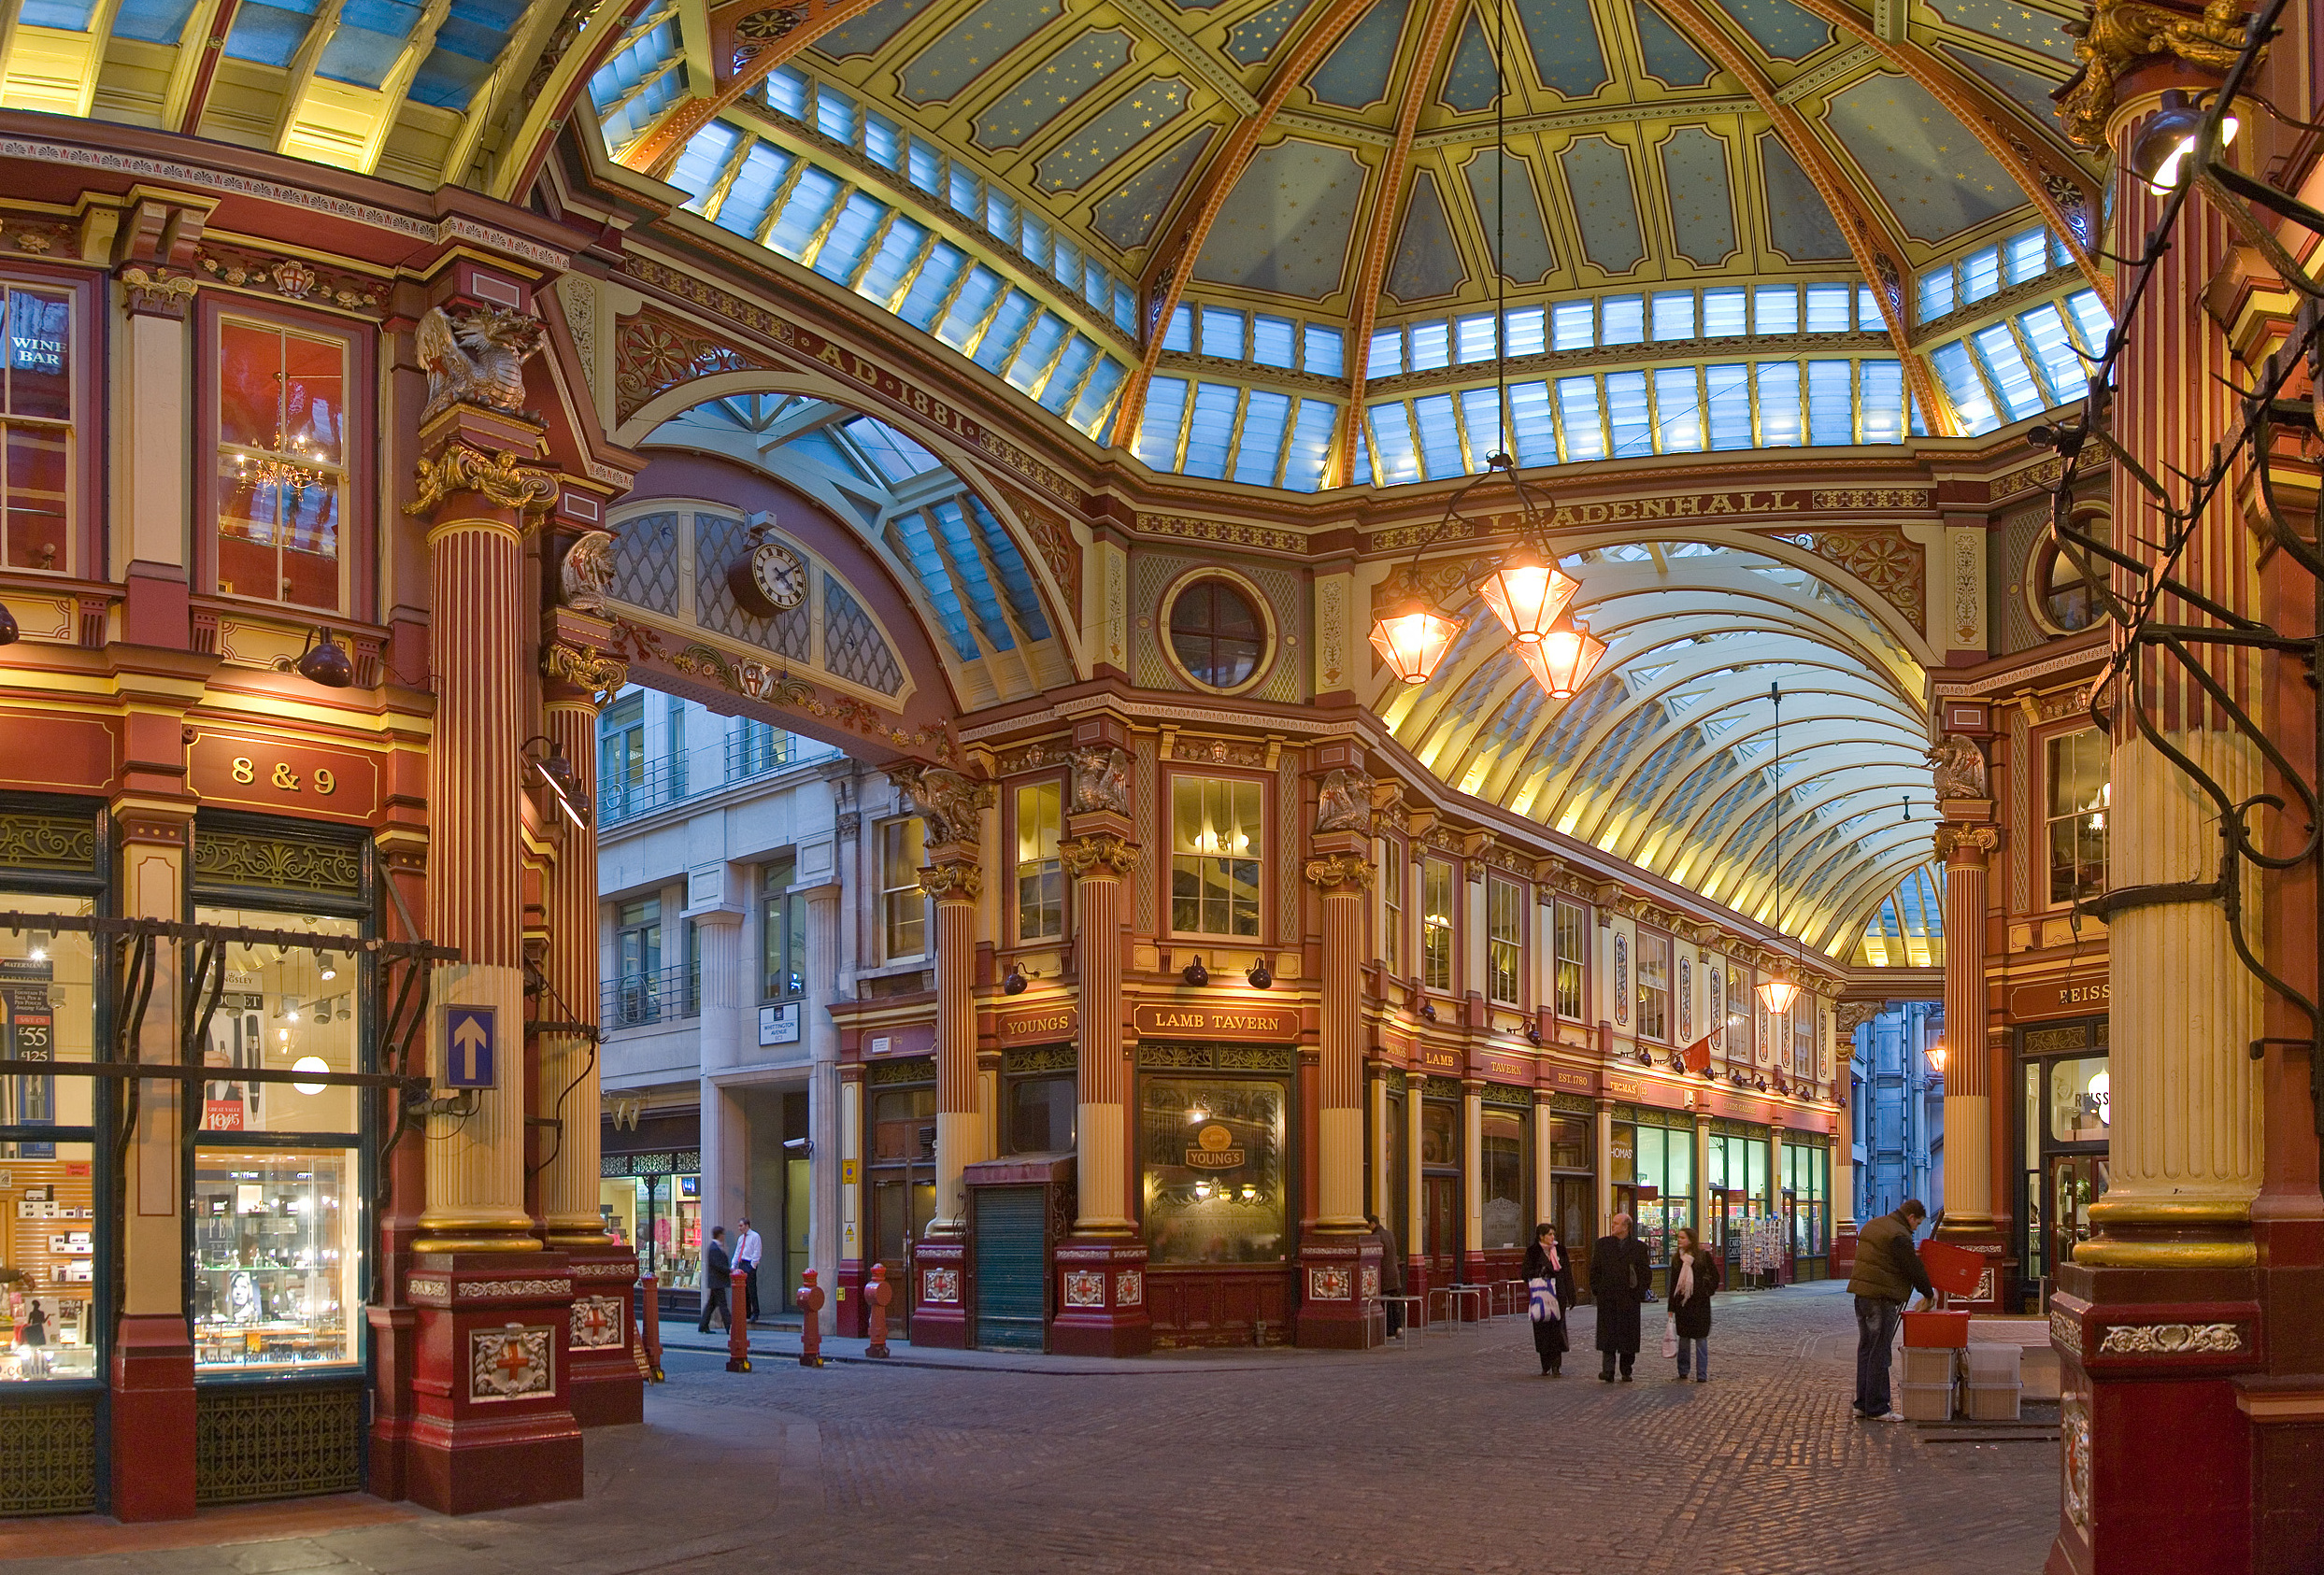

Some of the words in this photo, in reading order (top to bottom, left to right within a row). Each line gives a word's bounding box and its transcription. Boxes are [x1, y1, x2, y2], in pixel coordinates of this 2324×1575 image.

[11, 336, 67, 353] WINE
[20, 350, 59, 365] BAR
[899, 381, 964, 436] 1881
[232, 757, 254, 785] 8
[271, 762, 300, 791] &
[314, 768, 335, 795] 9
[223, 976, 253, 985] NGSLEY
[2059, 984, 2110, 1004] REISS
[763, 1022, 794, 1031] WHITTINGTON
[1007, 1015, 1069, 1035] YOUNGS
[1155, 1013, 1205, 1028] LAMB
[1212, 1015, 1279, 1031] TAVERN
[18, 1027, 48, 1046] £55
[1426, 1053, 1454, 1067] LAMB
[1490, 1061, 1522, 1076] TAVERN
[1191, 1153, 1240, 1165] YOUNG'S
[208, 1217, 235, 1239] PEN
